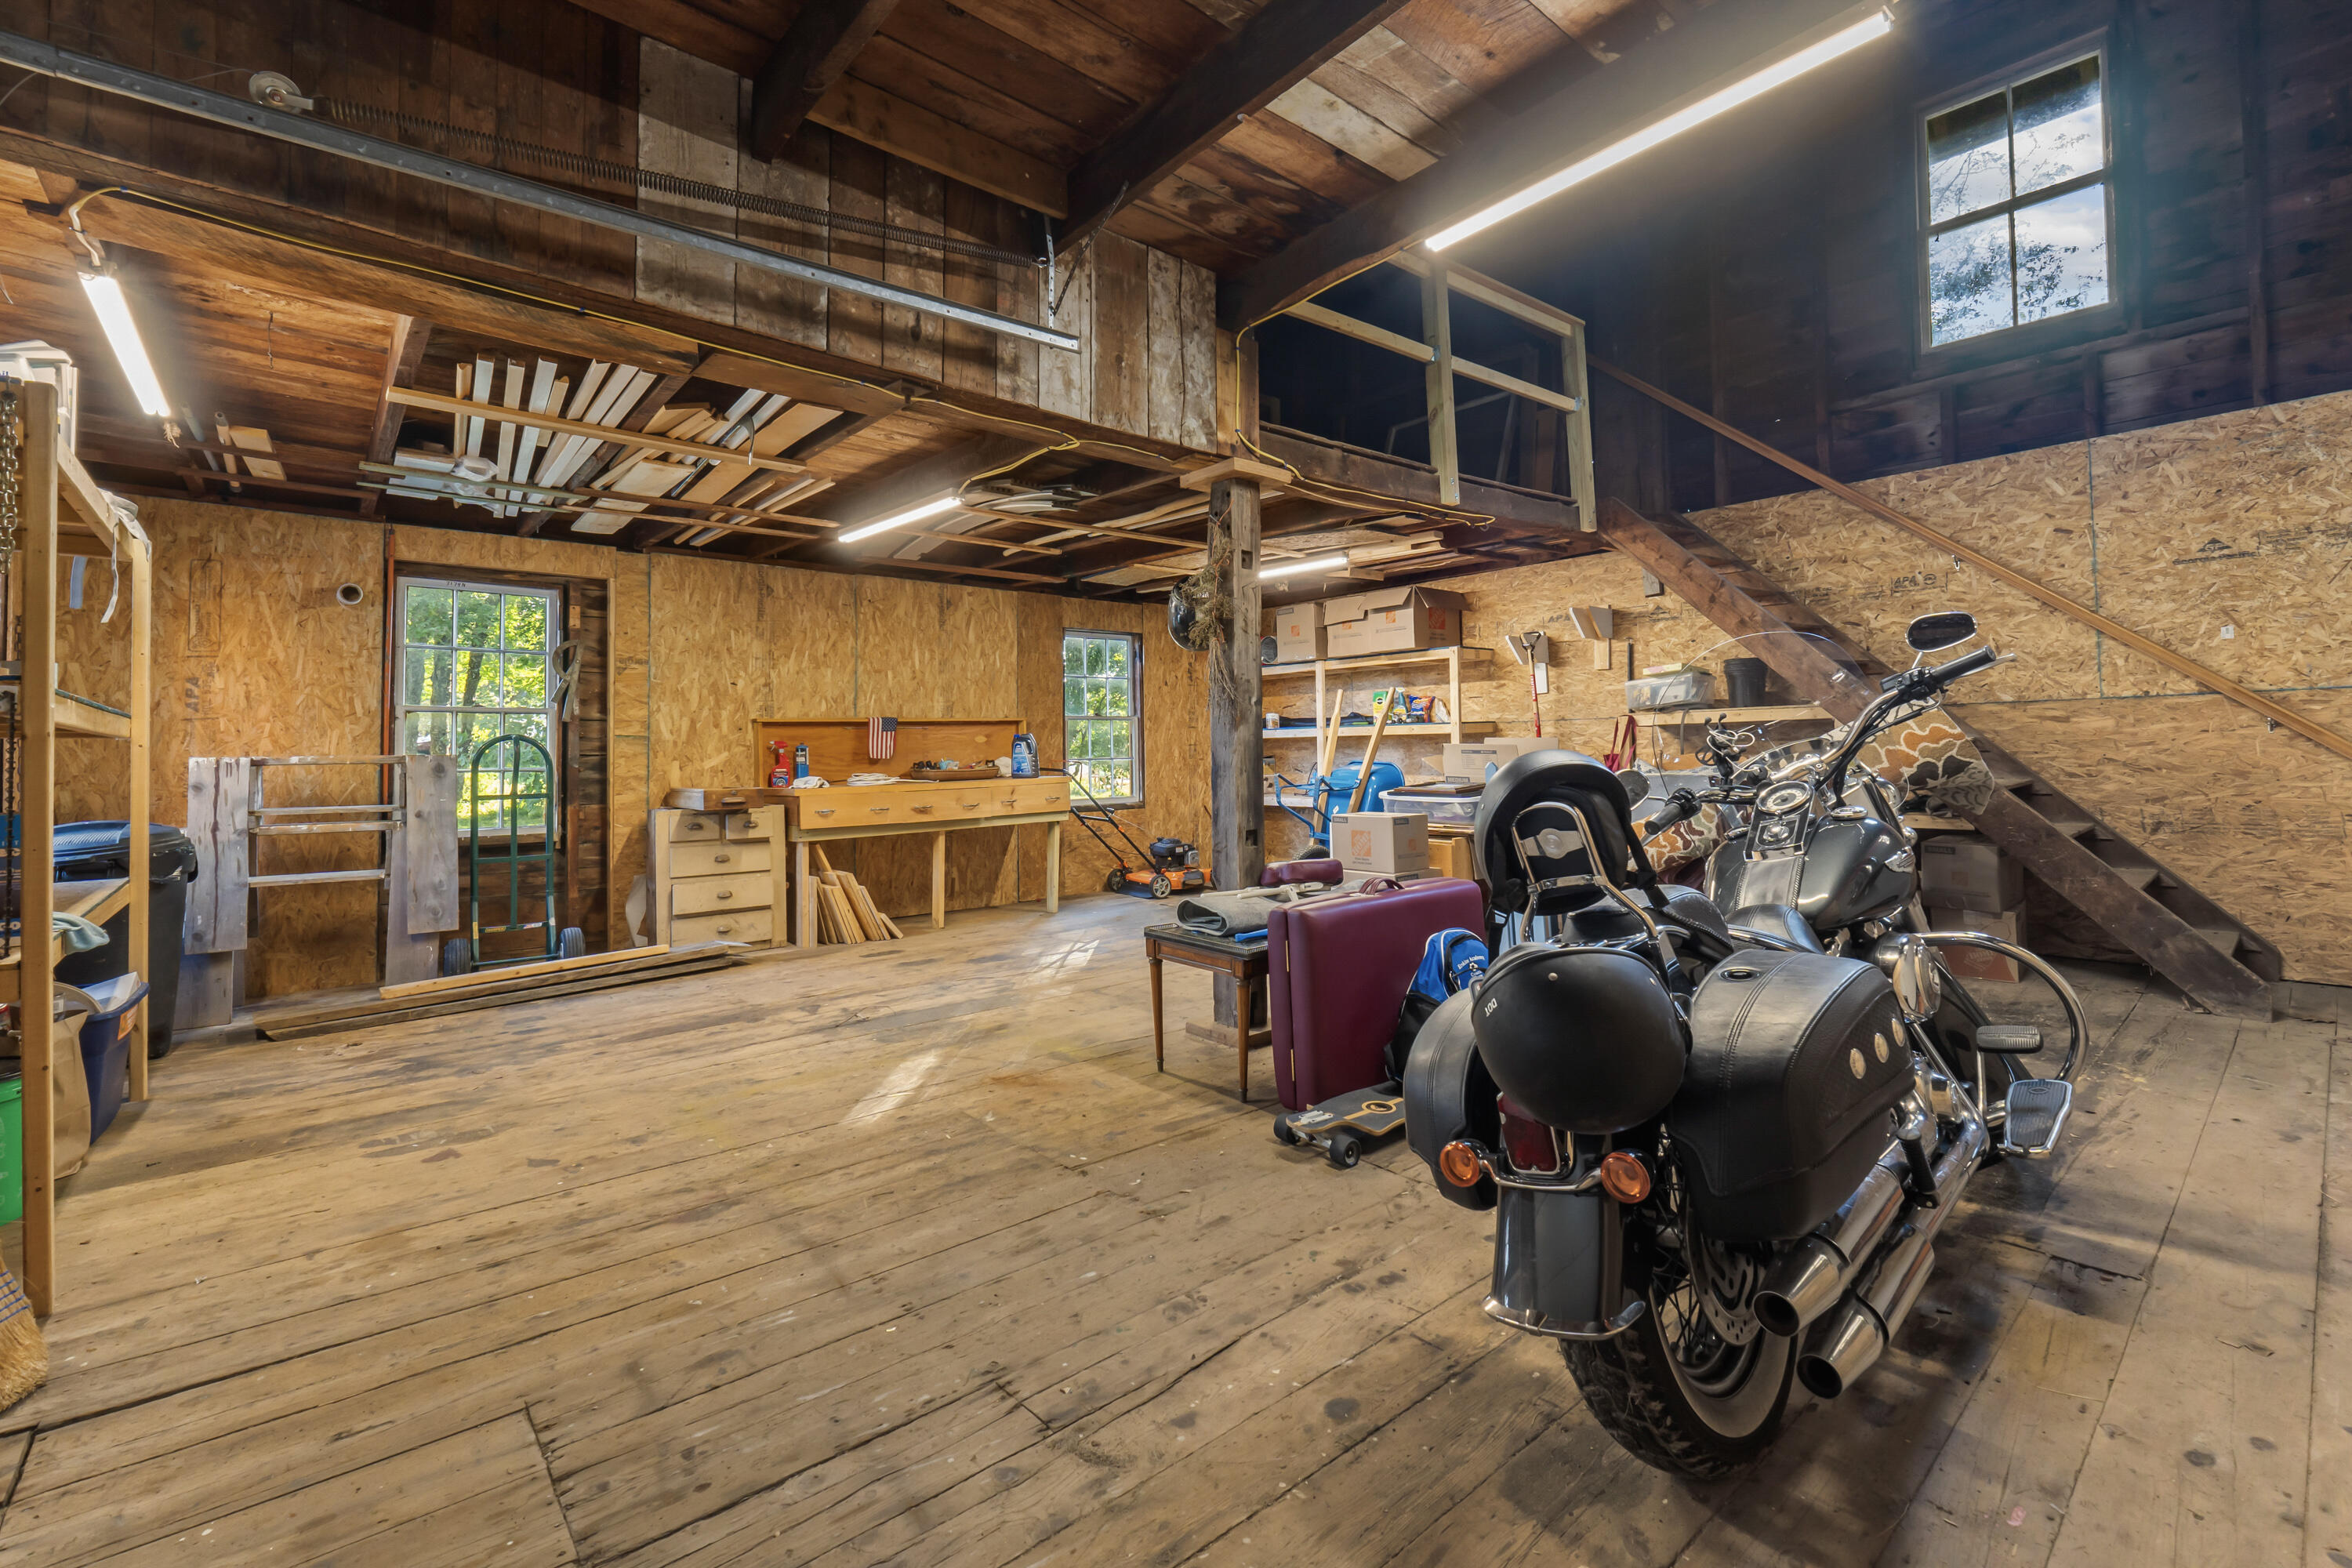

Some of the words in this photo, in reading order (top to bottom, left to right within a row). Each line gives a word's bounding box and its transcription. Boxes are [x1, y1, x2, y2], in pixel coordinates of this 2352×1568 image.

[1894, 576, 1918, 586] APA
[185, 677, 201, 713] APA
[1484, 997, 1497, 1018] DOT
